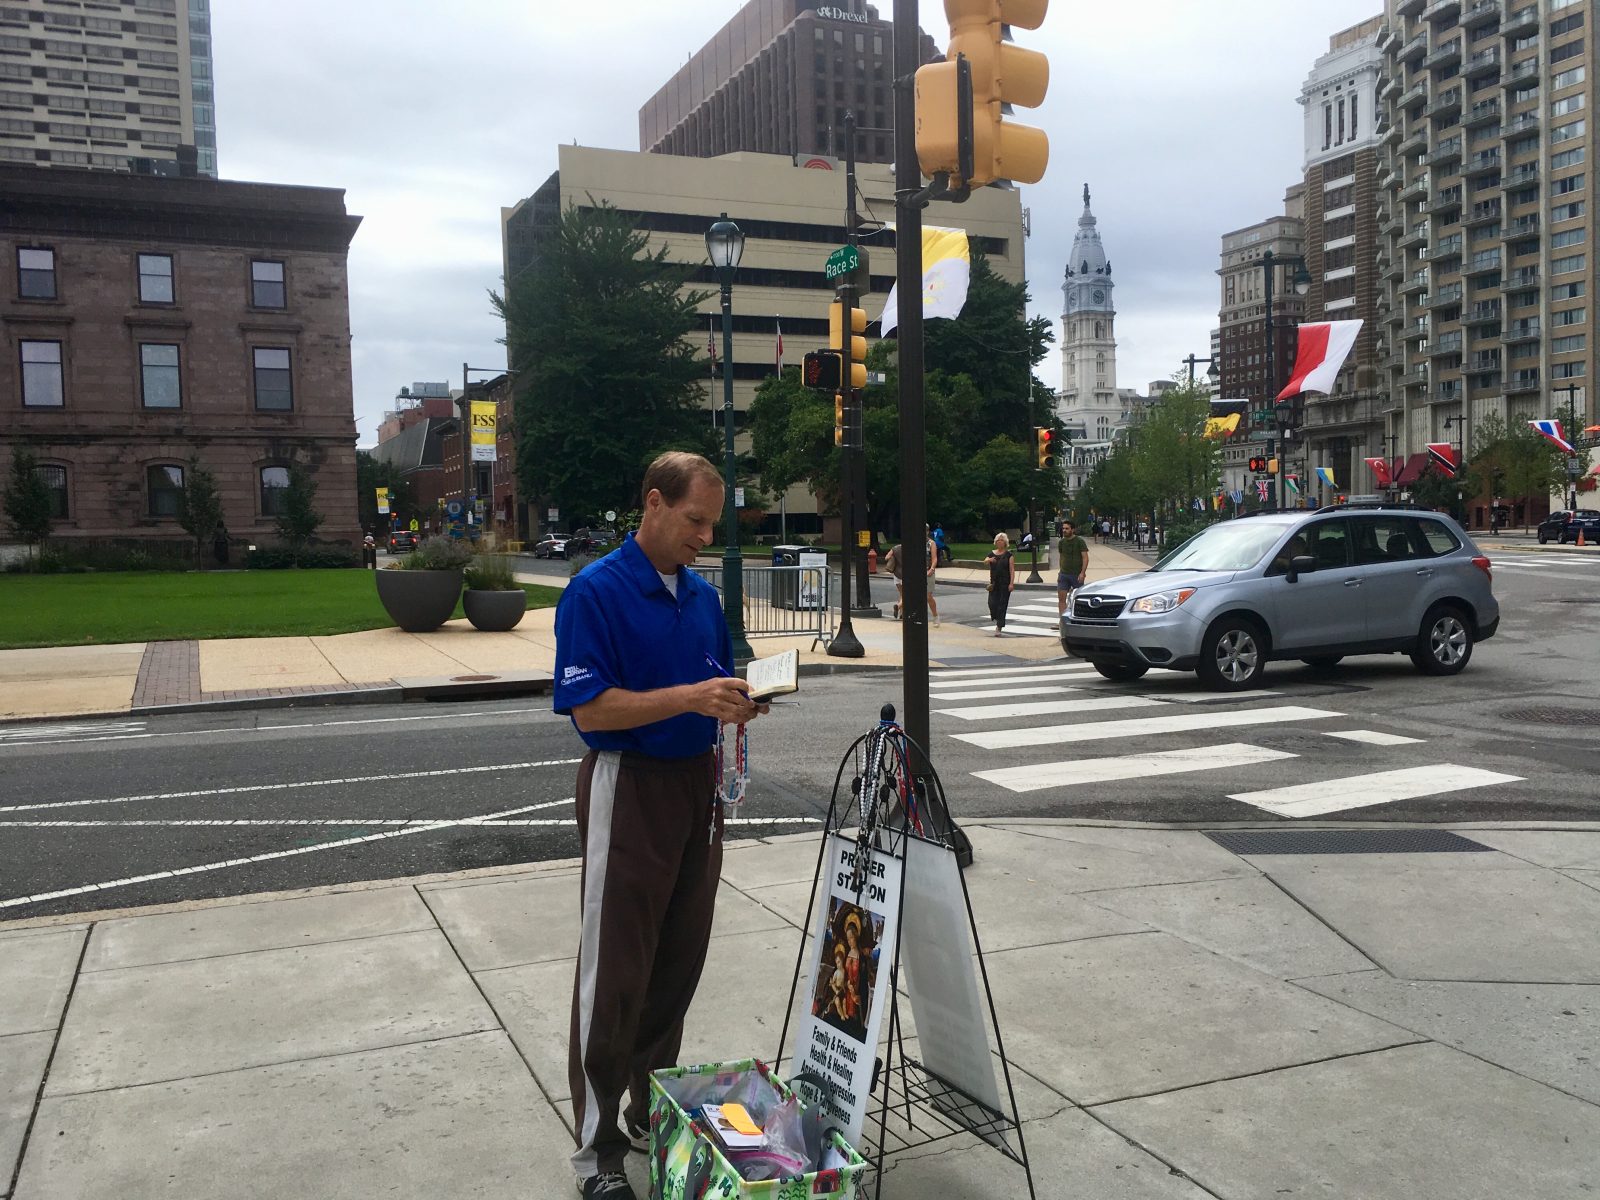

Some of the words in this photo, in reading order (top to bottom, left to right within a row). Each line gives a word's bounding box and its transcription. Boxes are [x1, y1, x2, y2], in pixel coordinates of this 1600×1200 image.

[833, 7, 868, 23] Drexel
[826, 261, 847, 279] Race
[849, 254, 858, 269] St
[472, 414, 496, 427] FSS
[840, 850, 886, 879] PRER
[836, 872, 887, 903] STON
[812, 1024, 831, 1051] Family
[830, 1035, 836, 1051] &
[836, 1038, 858, 1064] Friends
[800, 1059, 821, 1077] Anxit
[809, 1043, 827, 1067] Health
[826, 1054, 833, 1070] &
[832, 1057, 853, 1087] Healing
